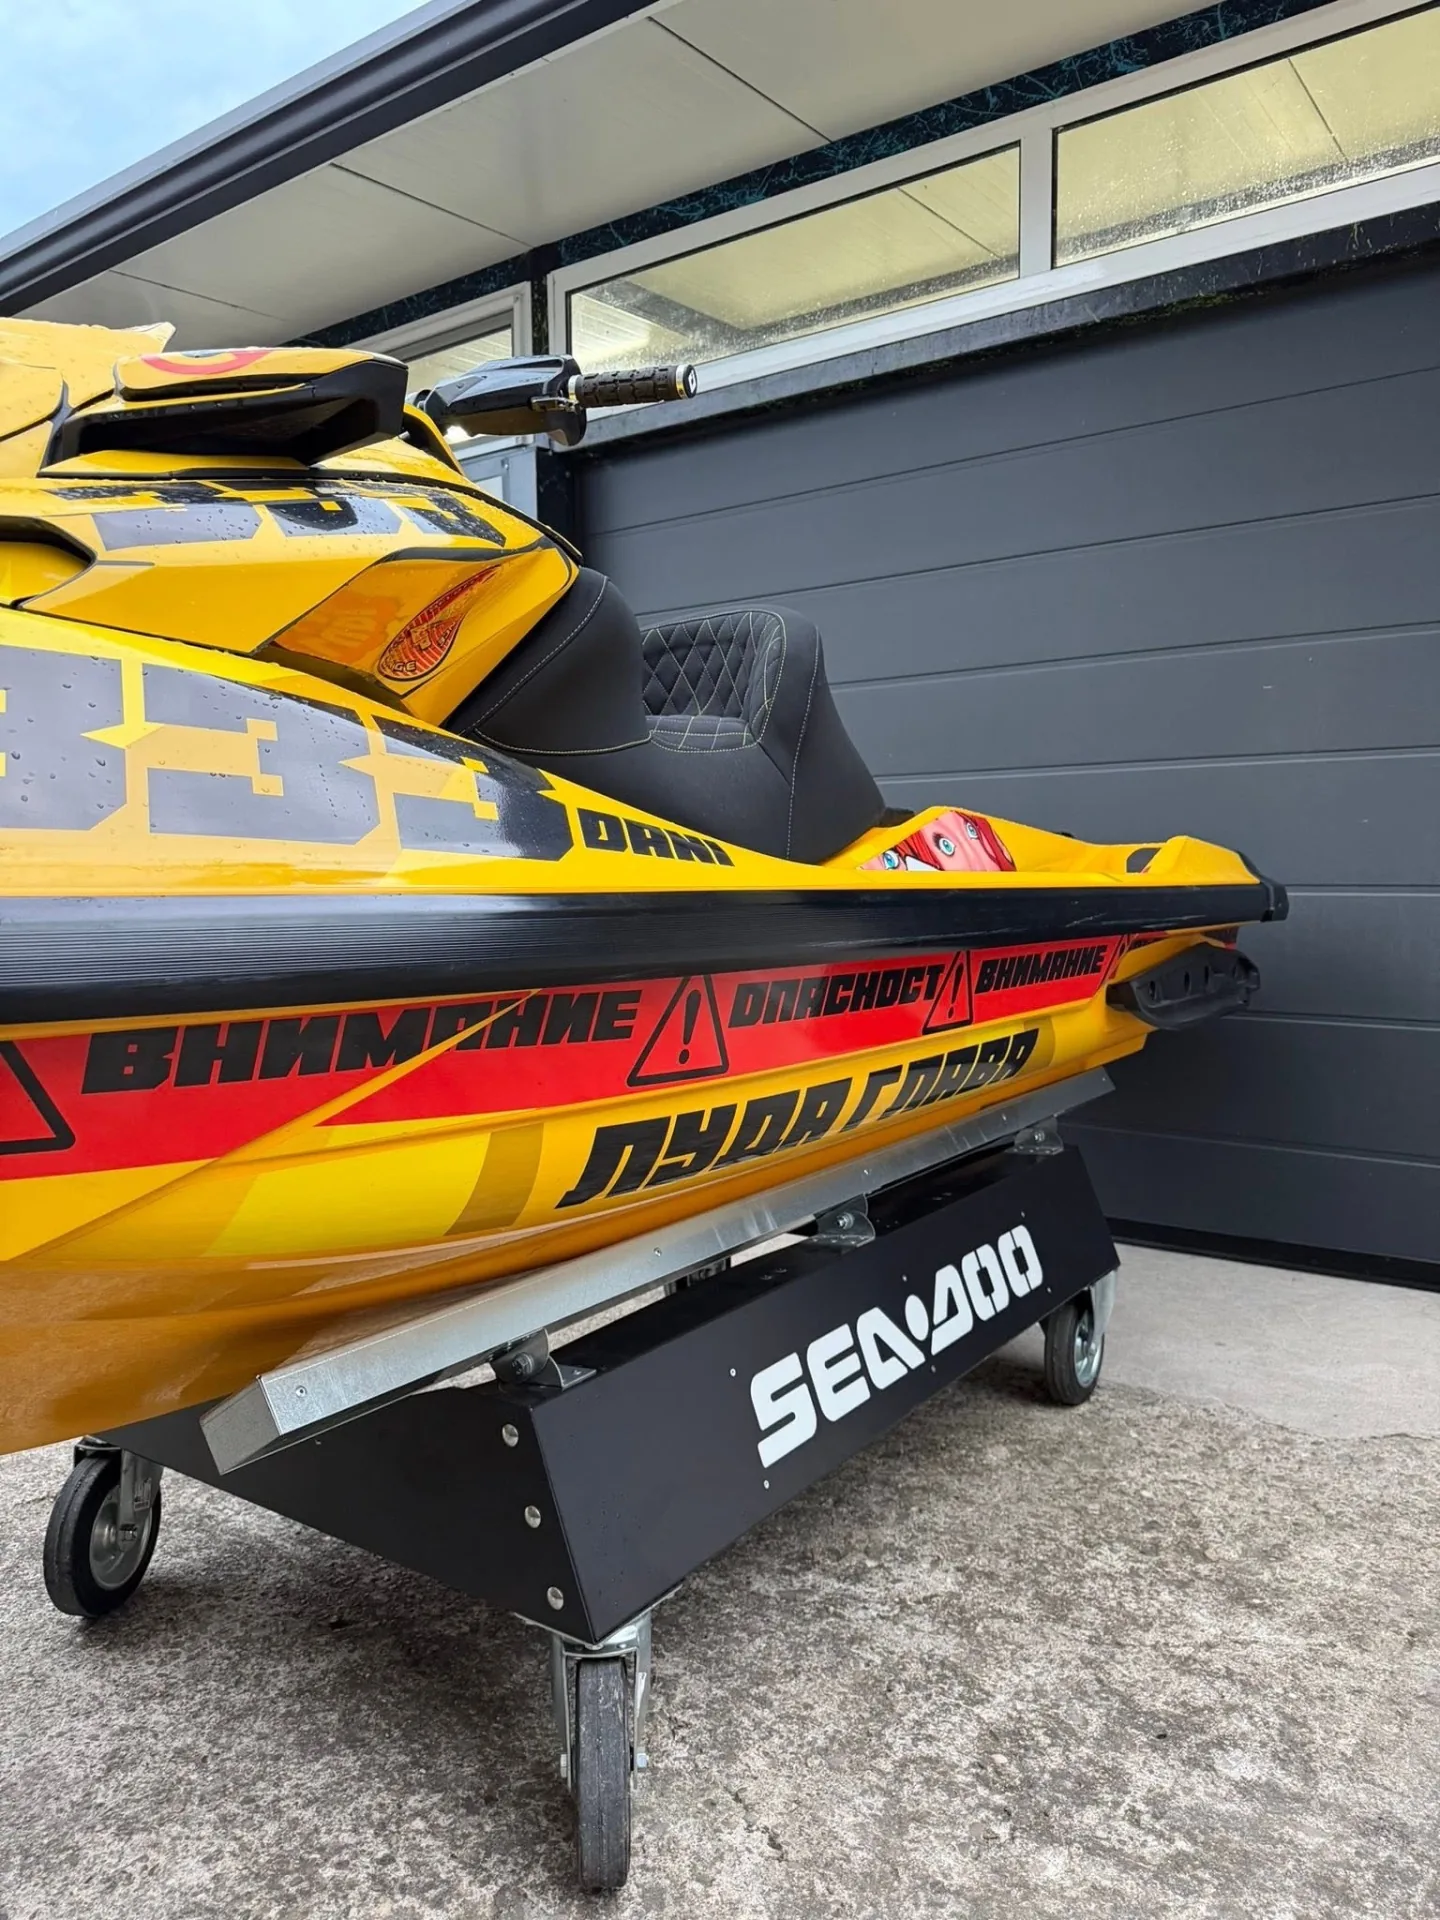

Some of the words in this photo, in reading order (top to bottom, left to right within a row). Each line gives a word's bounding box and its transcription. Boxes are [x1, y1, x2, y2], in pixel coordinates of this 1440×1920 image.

[576, 807, 735, 867] DANI
[728, 964, 945, 1028] ОПАСНОСТ
[974, 945, 1108, 994] ВНИМАНИЕ
[82, 990, 641, 1094] ВНИМАНИЕ
